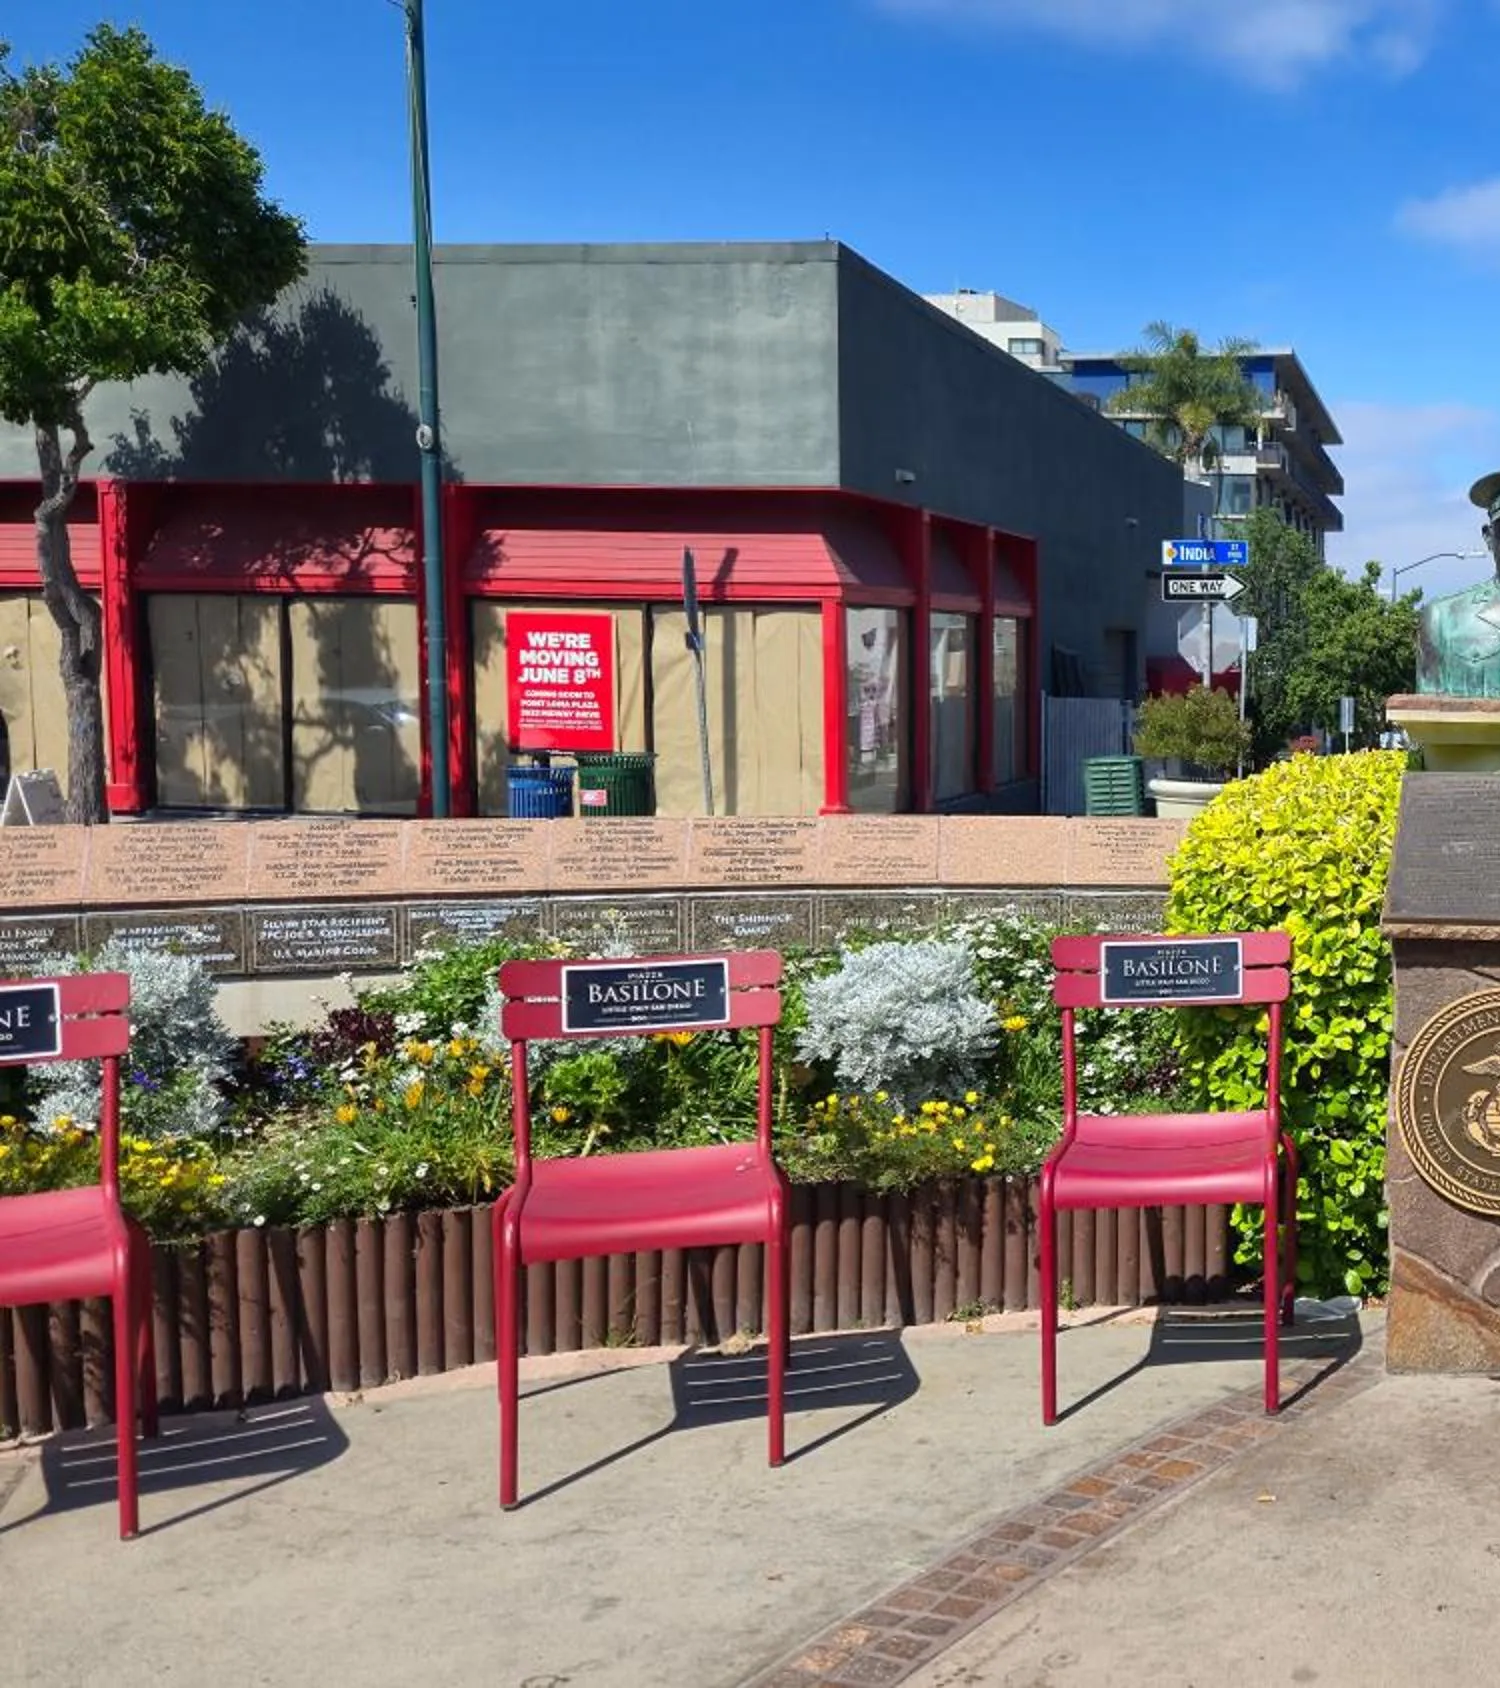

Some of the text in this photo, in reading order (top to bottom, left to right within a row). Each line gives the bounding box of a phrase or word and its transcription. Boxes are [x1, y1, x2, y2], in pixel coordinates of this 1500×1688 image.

[1180, 545, 1216, 560] INDIA
[1172, 581, 1223, 593] ONE WAY
[527, 631, 591, 649] WE'RE
[520, 649, 599, 667] MOVING
[518, 667, 570, 684] JUNE
[263, 917, 388, 930] SILVER STAR RECIPIENT
[714, 915, 735, 924] THE
[296, 948, 339, 958] MARINE
[342, 946, 378, 955] CORPS
[1157, 948, 1188, 956] PIAZZA
[1123, 956, 1223, 977] BASILONE
[627, 971, 664, 980] PIAZZA
[1135, 979, 1157, 987] LITTLE
[1189, 977, 1211, 985] DIEGO
[588, 978, 707, 1004] BASILONE
[601, 1001, 693, 1013] LITTLE ITALY SAN DIEGO
[1418, 1113, 1452, 1164] UNITED
